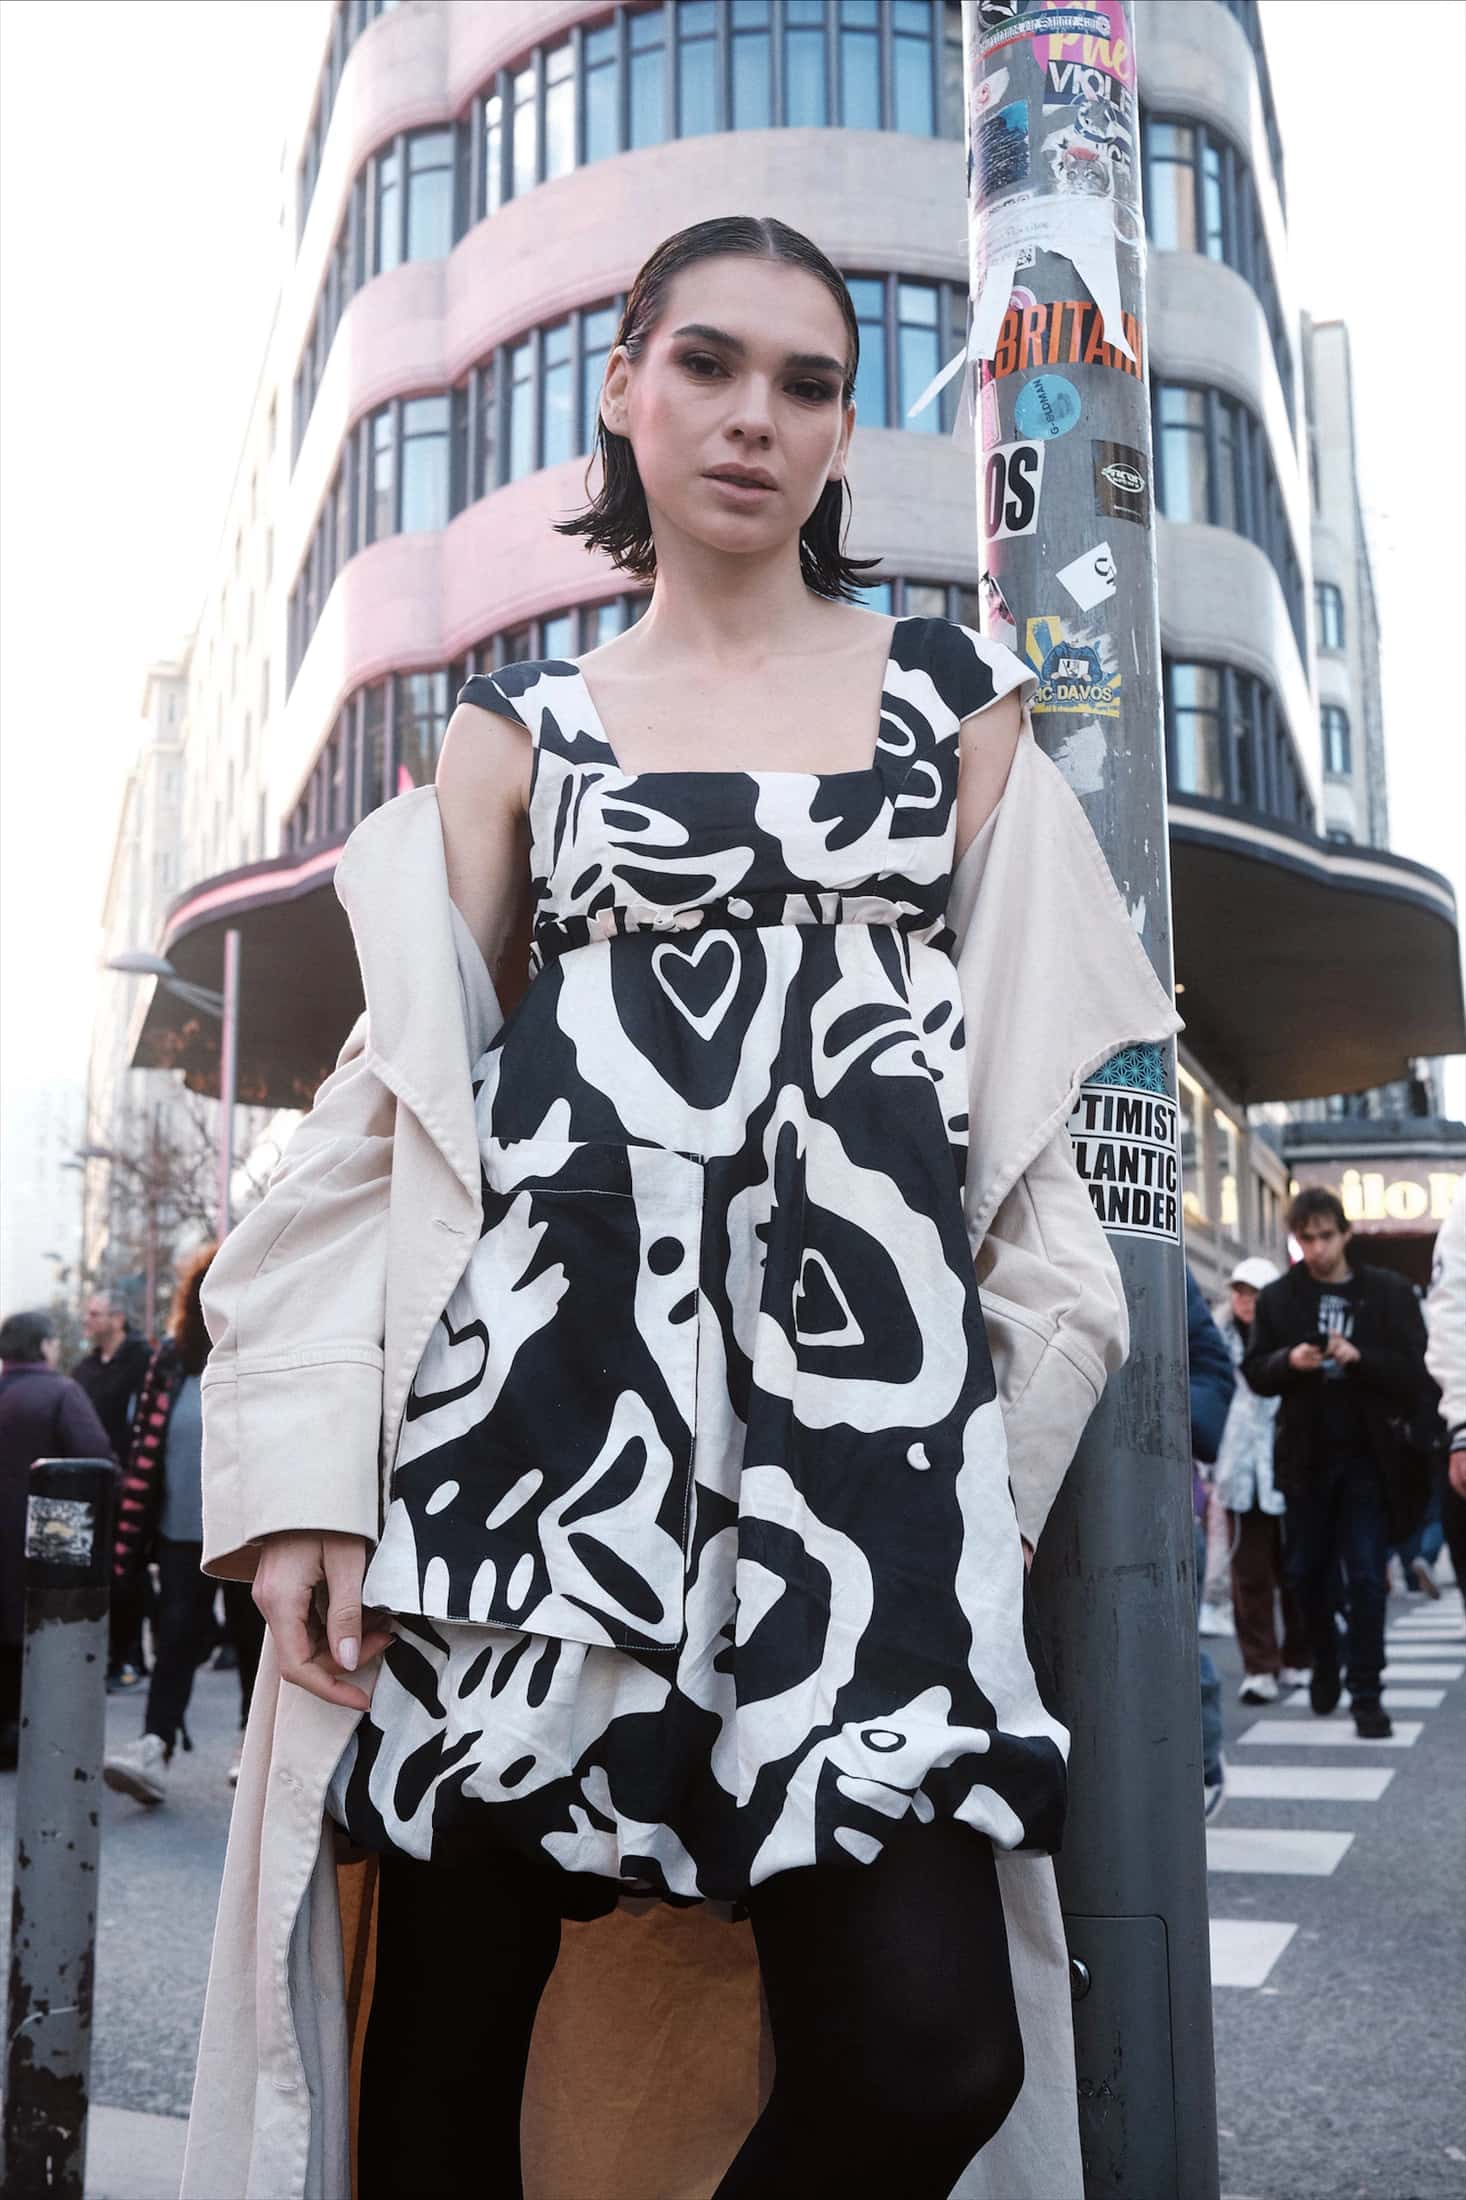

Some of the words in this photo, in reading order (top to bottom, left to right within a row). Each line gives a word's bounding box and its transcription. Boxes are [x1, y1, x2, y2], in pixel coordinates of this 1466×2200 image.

[1056, 684, 1112, 702] DAVOS
[1071, 1094, 1176, 1145] TIMIST
[1072, 1141, 1177, 1193] LANTIC
